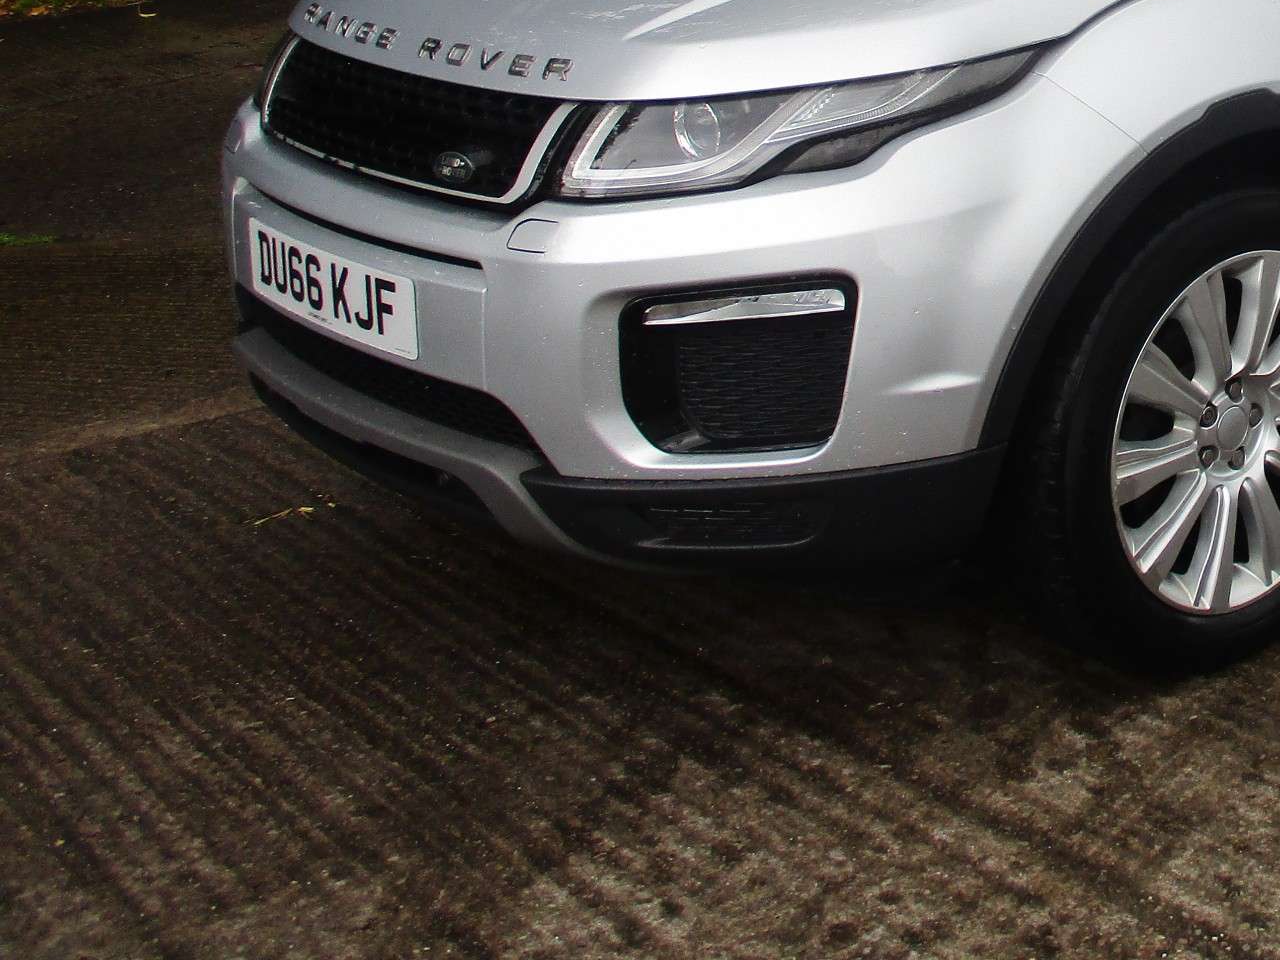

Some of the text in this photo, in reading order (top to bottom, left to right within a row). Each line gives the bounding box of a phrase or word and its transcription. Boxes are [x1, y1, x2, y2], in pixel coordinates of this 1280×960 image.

[303, 1, 576, 83] RANGE ROVER
[257, 230, 396, 336] DU66 KJF
